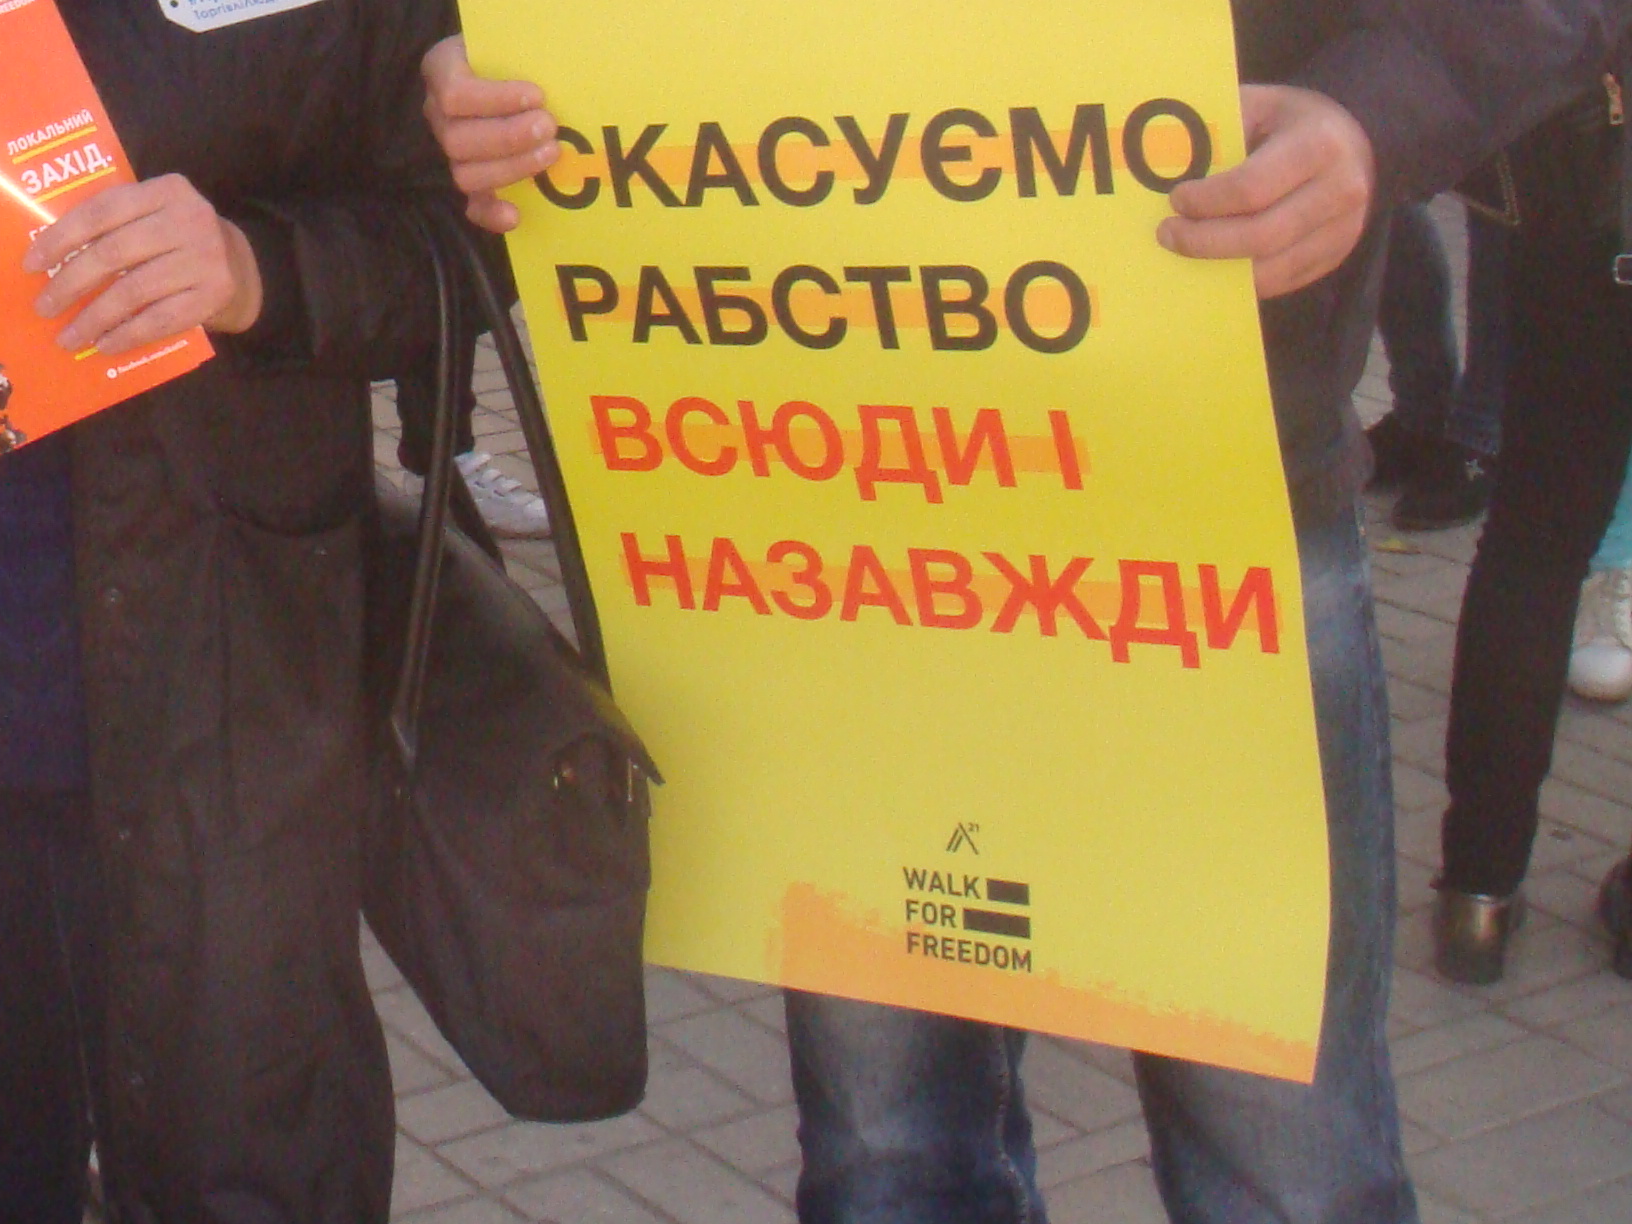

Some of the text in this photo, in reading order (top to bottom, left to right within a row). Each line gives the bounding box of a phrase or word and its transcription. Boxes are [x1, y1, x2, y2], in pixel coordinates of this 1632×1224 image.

[7, 109, 94, 156] ЛОКАЛЬНИЙ
[532, 97, 1213, 209] СКАСУЄМО
[21, 142, 114, 194] ЗАХІД.
[554, 259, 1092, 355] РАБСТВО
[589, 394, 1085, 504] ВСЮДИ І
[619, 531, 1282, 669] НАЗАВЖДИ
[902, 865, 982, 901] WALK
[905, 898, 957, 929] FOR
[906, 931, 1033, 974] FREEDOM
